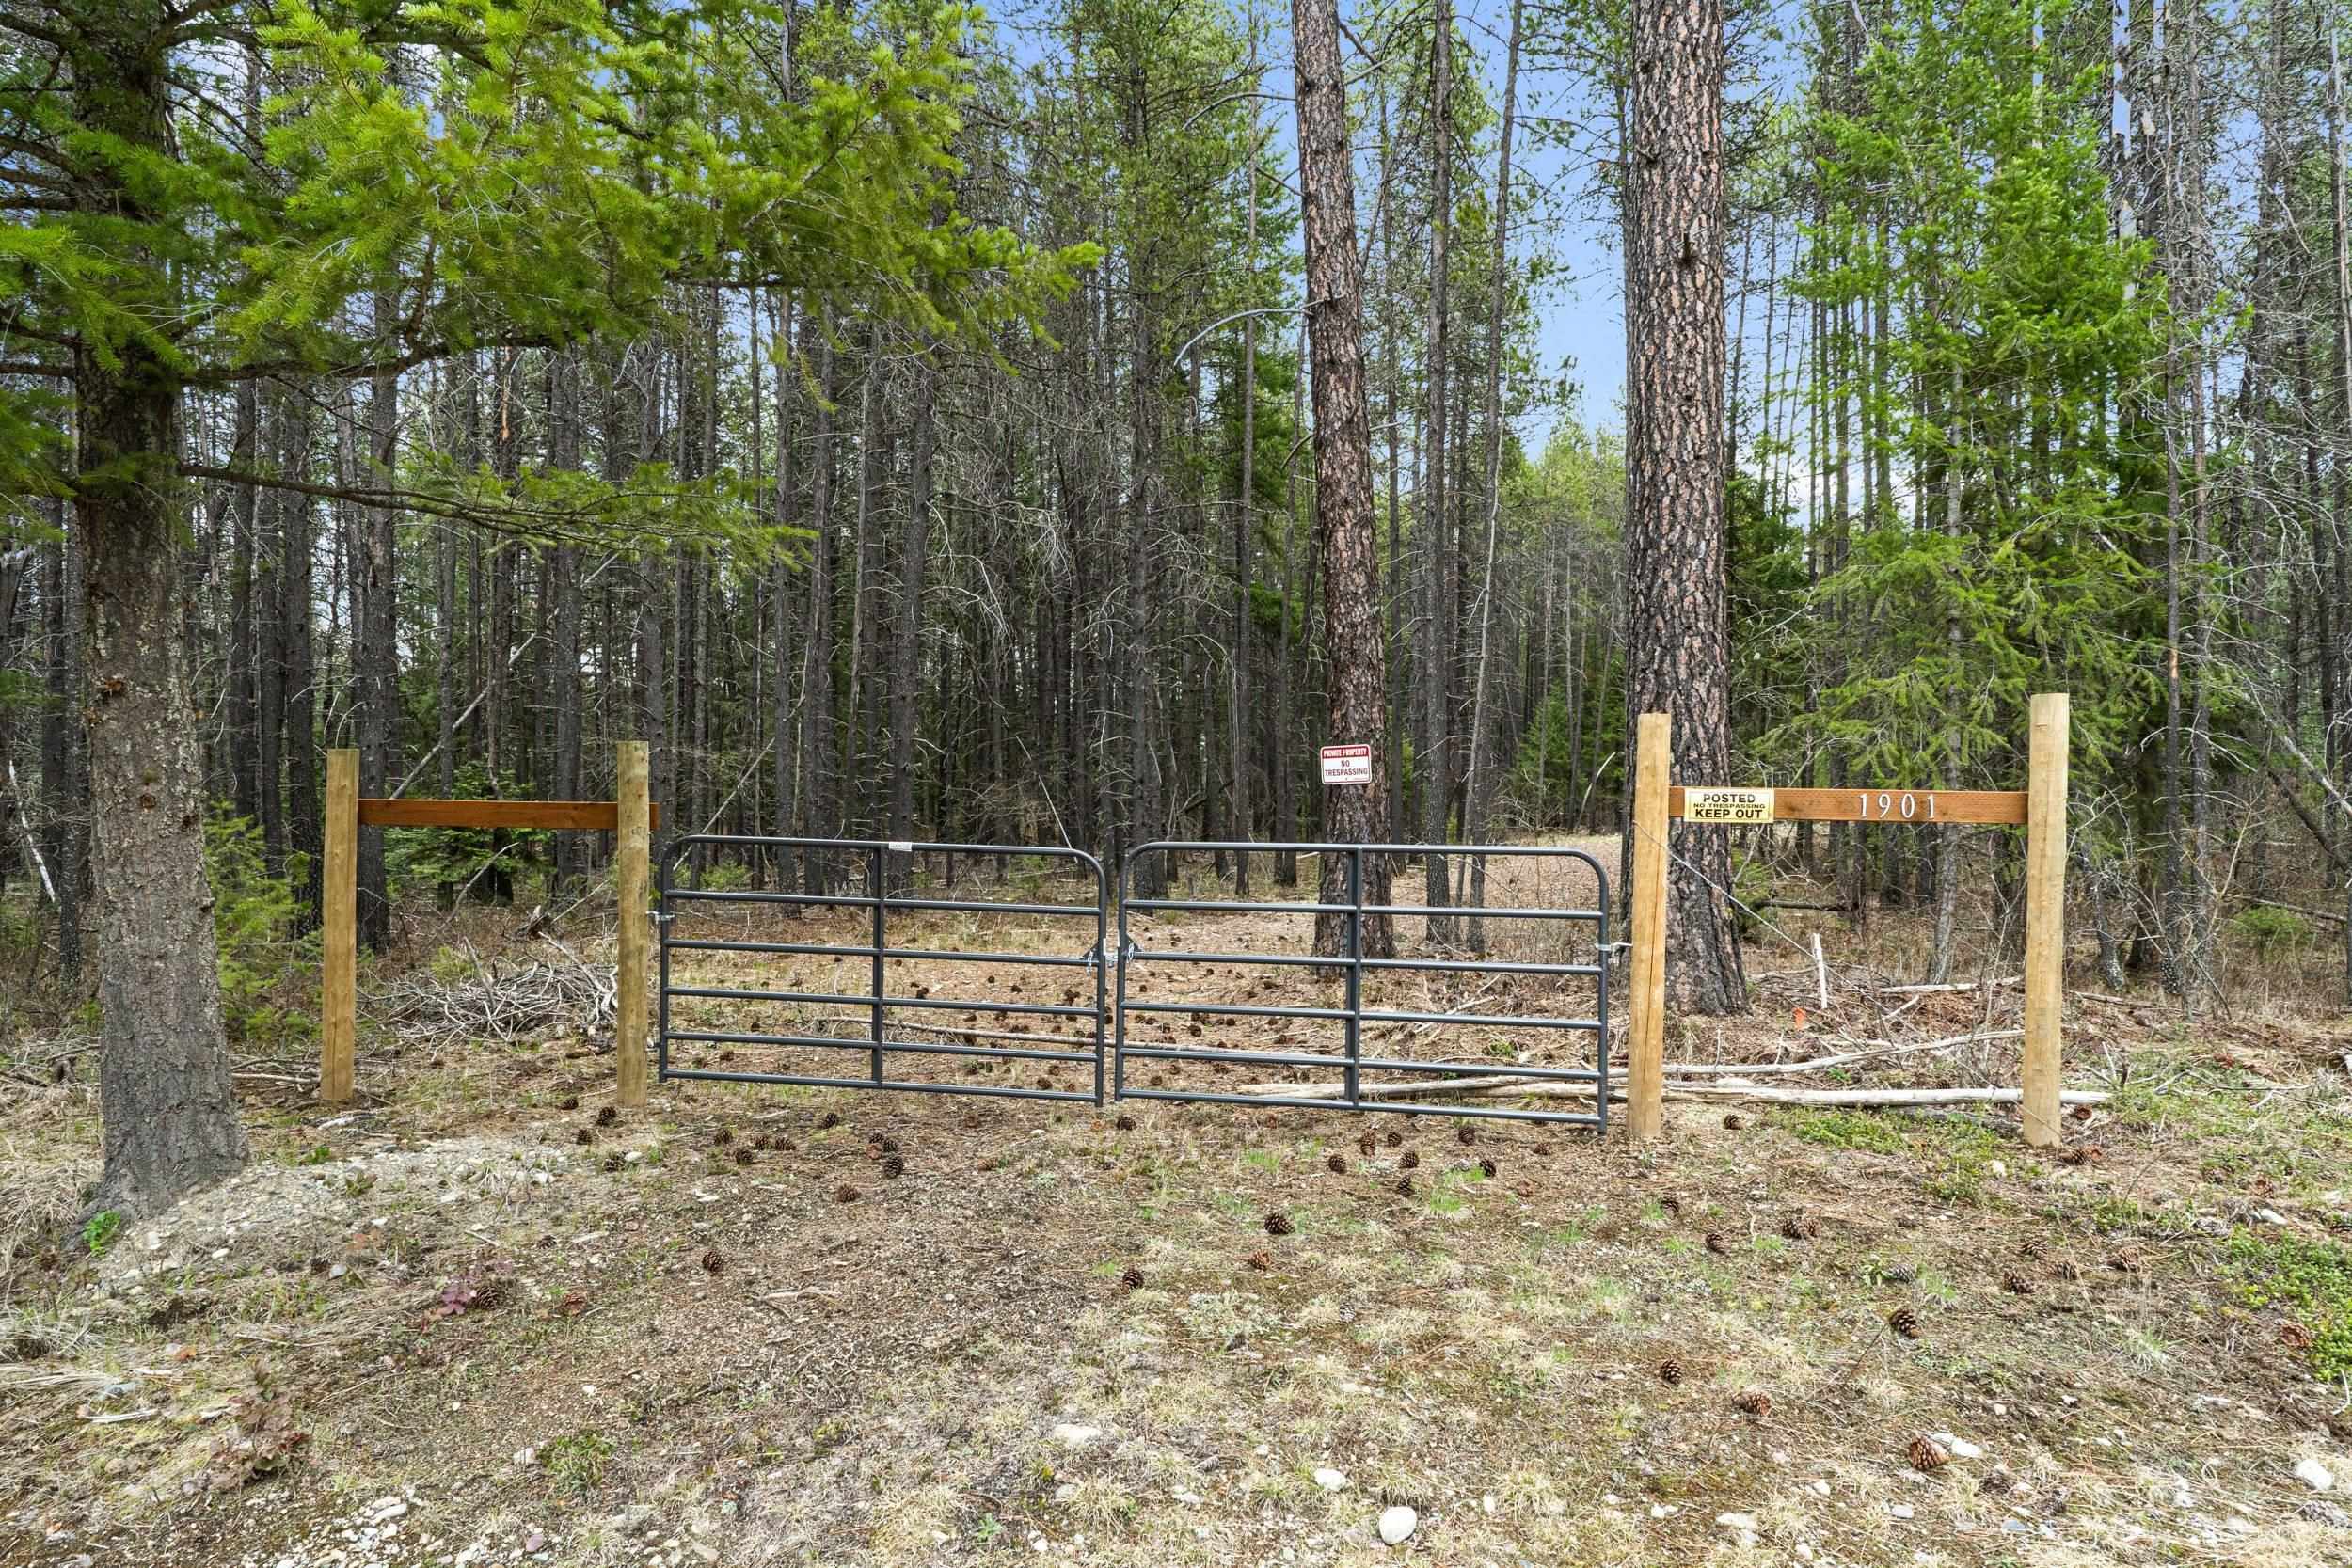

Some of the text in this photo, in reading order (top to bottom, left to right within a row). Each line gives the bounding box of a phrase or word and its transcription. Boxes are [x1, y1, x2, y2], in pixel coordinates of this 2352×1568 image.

[1343, 748, 1367, 756] PROPERTY
[1325, 768, 1368, 776] TRESPASSING
[1703, 793, 1756, 803] POSTED
[1859, 793, 1935, 819] 1901
[1695, 809, 1763, 818] KEEP OUT
